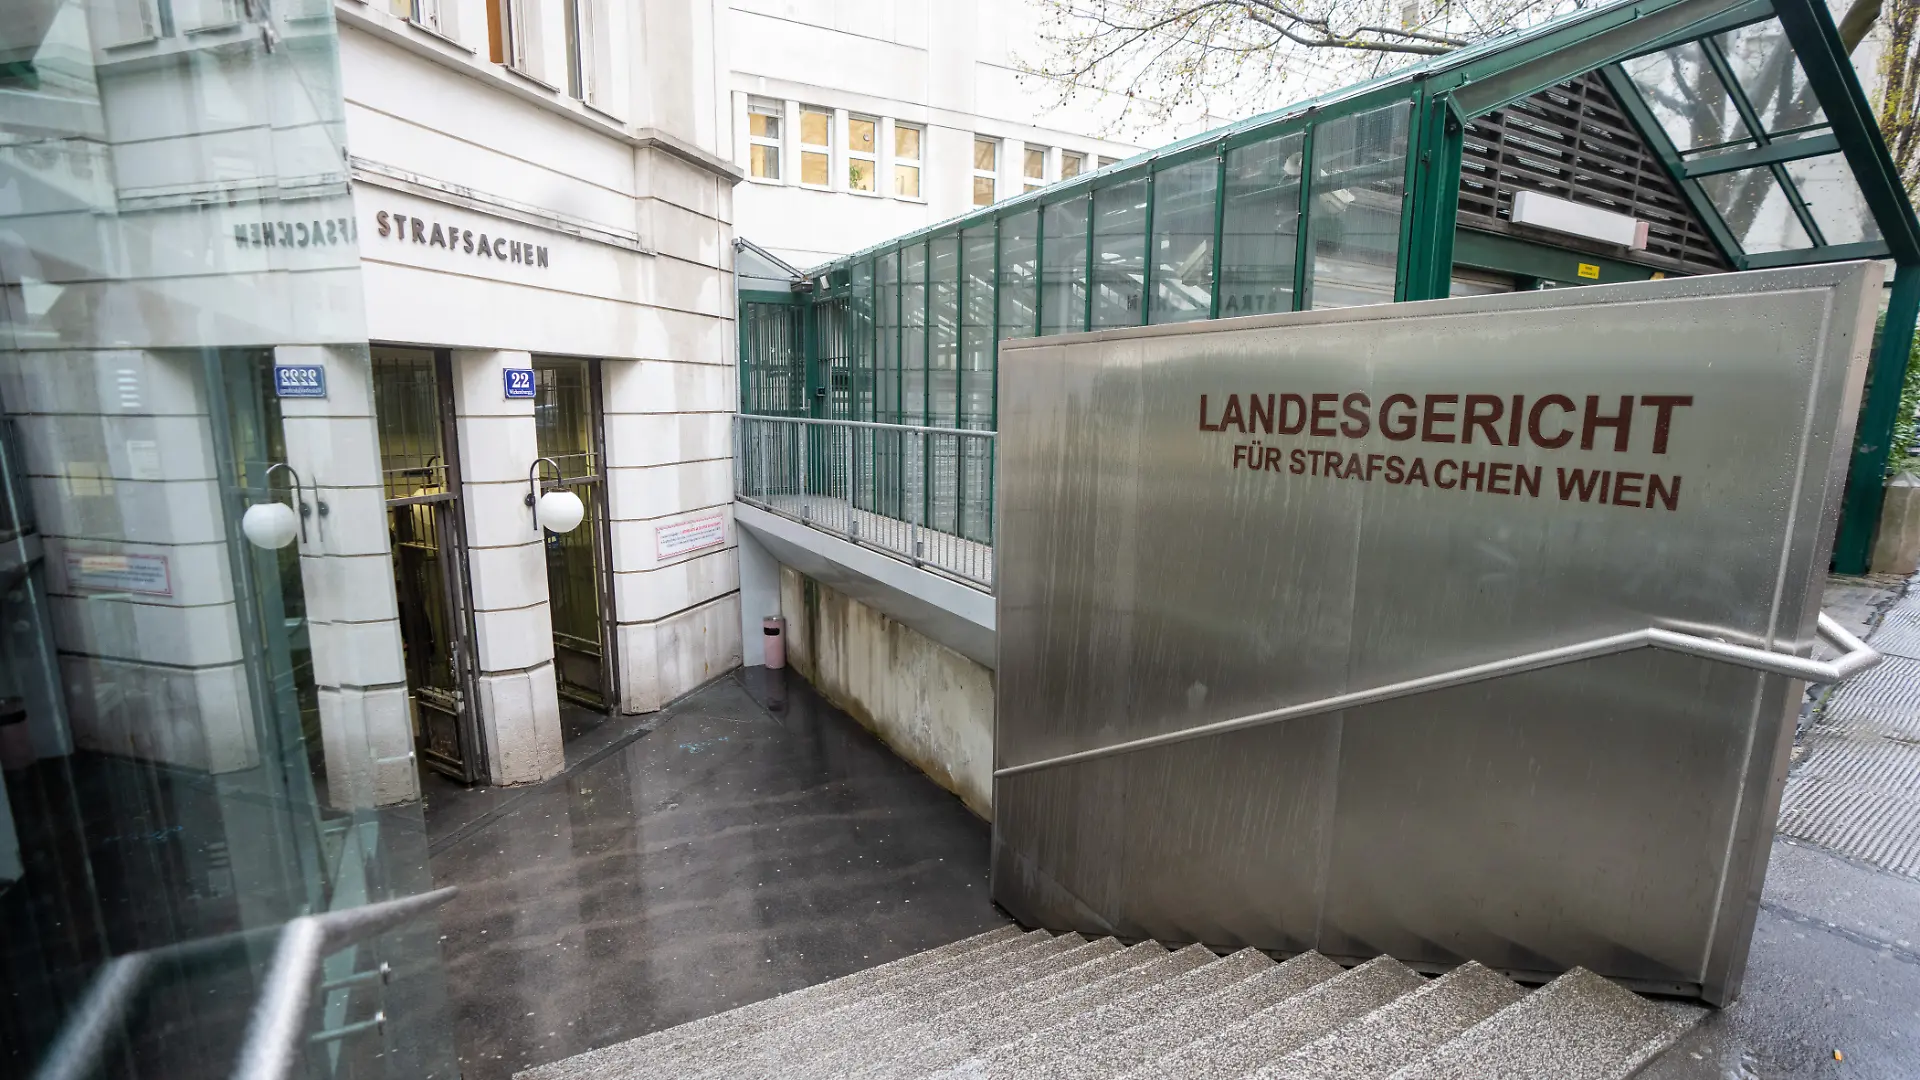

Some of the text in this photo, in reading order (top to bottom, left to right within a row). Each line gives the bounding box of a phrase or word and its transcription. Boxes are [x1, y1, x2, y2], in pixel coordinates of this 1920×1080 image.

[376, 210, 549, 268] STRAFSACHEN
[511, 372, 530, 388] 22
[1199, 392, 1694, 455] LANDESGERICHT
[1233, 440, 1682, 511] FÜR STRAFSACHEN WIEN
